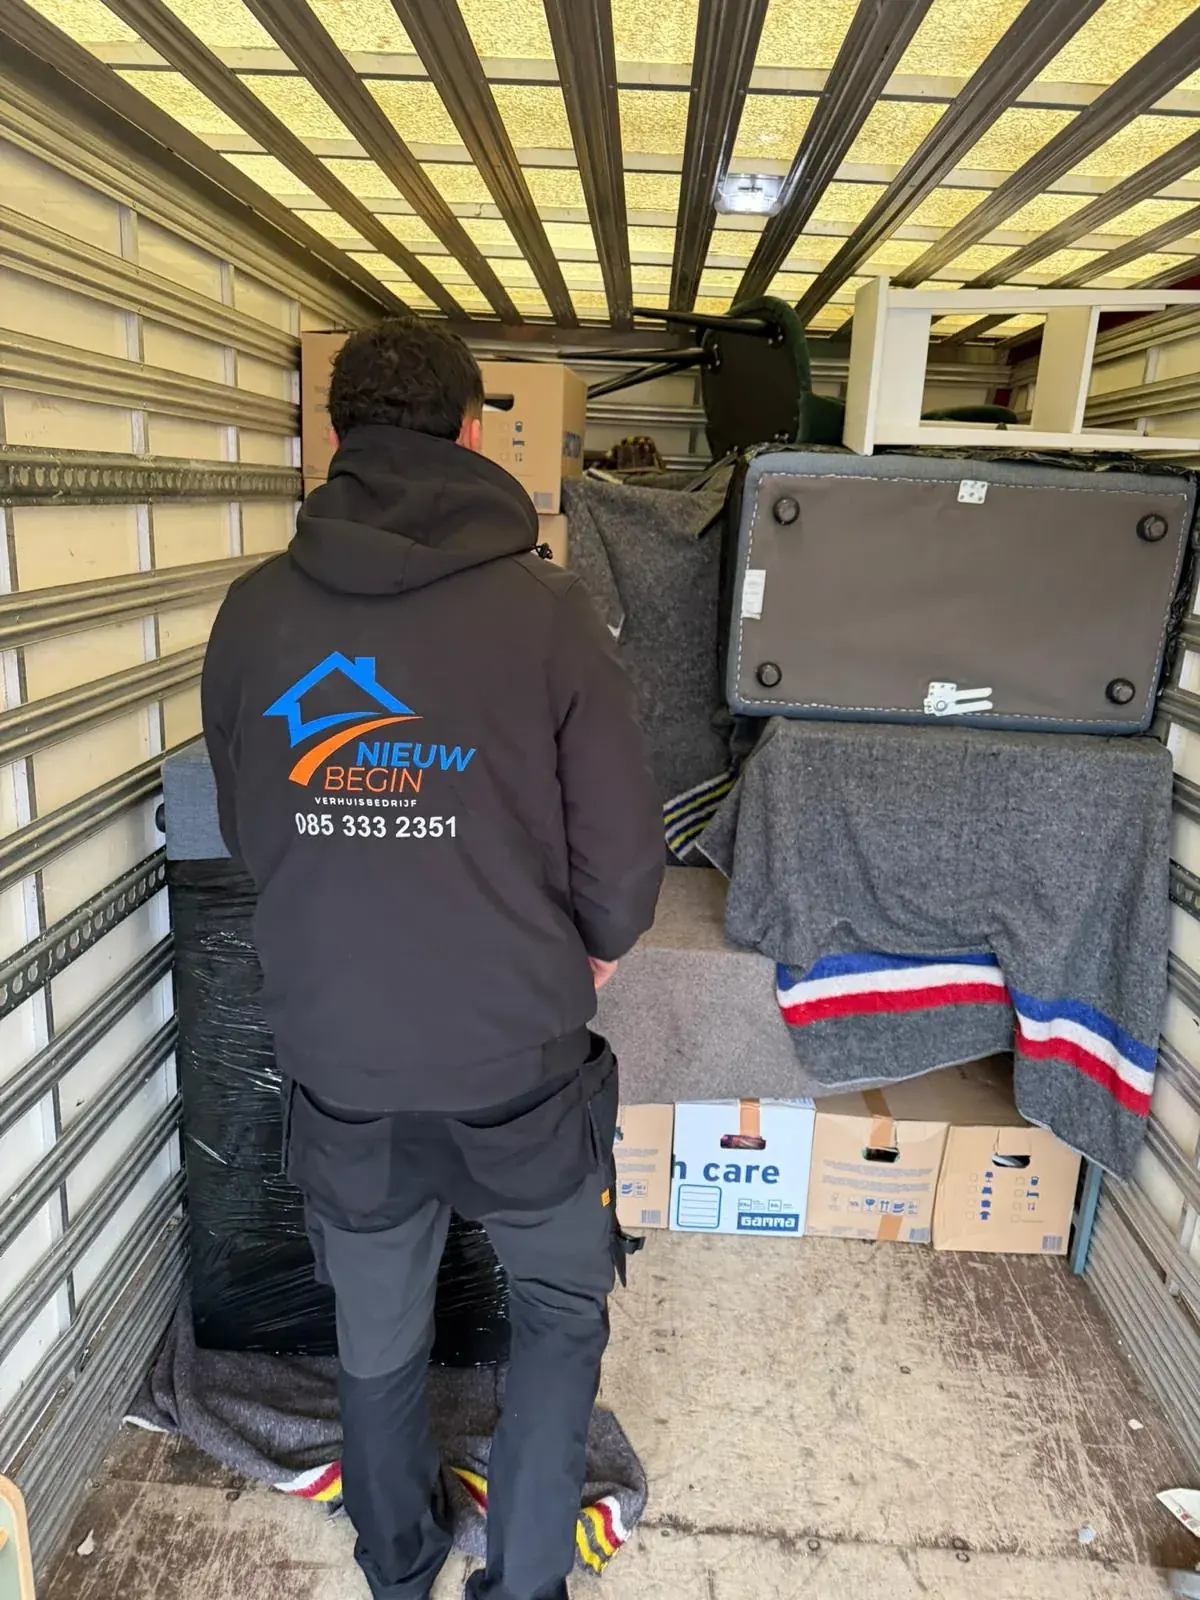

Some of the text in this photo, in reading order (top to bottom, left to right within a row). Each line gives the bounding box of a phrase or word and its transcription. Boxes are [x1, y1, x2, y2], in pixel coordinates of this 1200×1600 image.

[356, 741, 476, 771] NIEUW
[324, 766, 423, 793] BEGIN
[314, 797, 418, 808] VERHUISBEDRIJF
[295, 812, 456, 839] 085 333 2351
[703, 1162, 780, 1184] care
